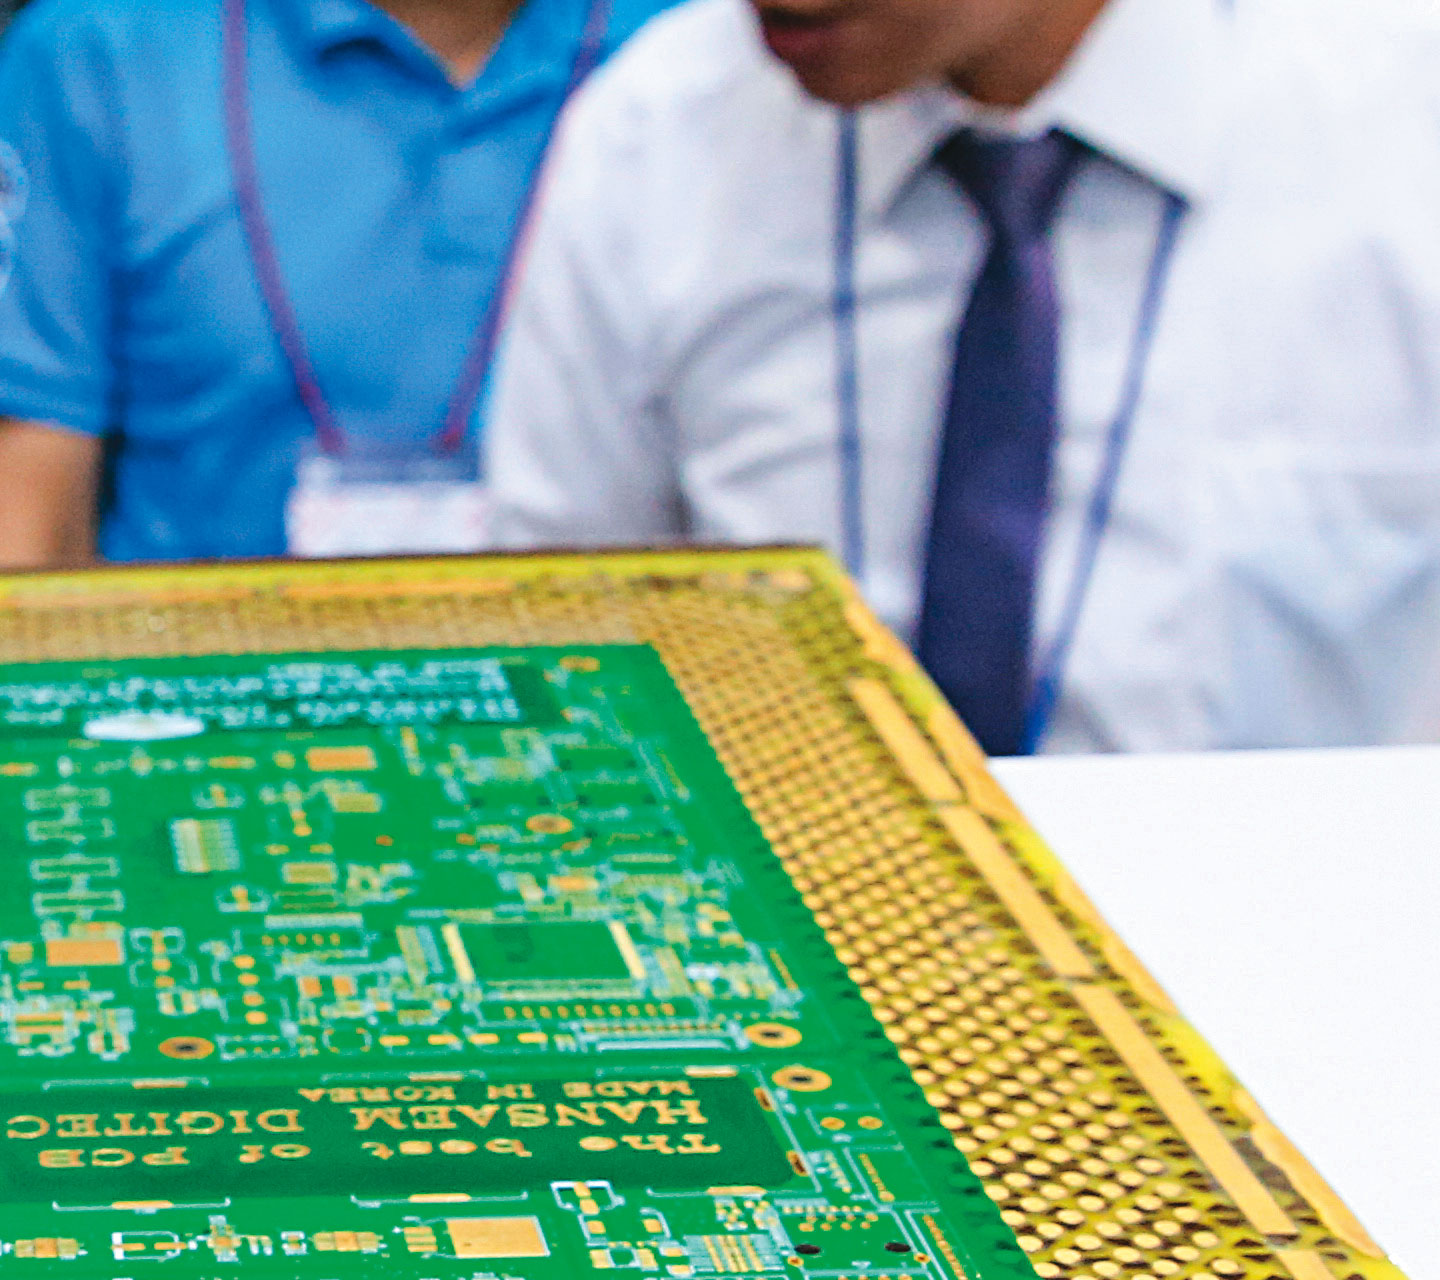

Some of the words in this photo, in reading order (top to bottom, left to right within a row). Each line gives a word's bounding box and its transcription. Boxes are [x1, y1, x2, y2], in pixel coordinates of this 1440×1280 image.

[298, 1085, 455, 1102] KOREA
[486, 1083, 536, 1098] IN
[563, 1080, 692, 1096] MADE
[5, 1107, 303, 1138] DIGITEC
[351, 1099, 706, 1129] HANSAEM
[237, 1142, 311, 1162] of
[361, 1137, 527, 1158] best
[578, 1133, 720, 1154] The
[38, 1146, 189, 1167] PCB
